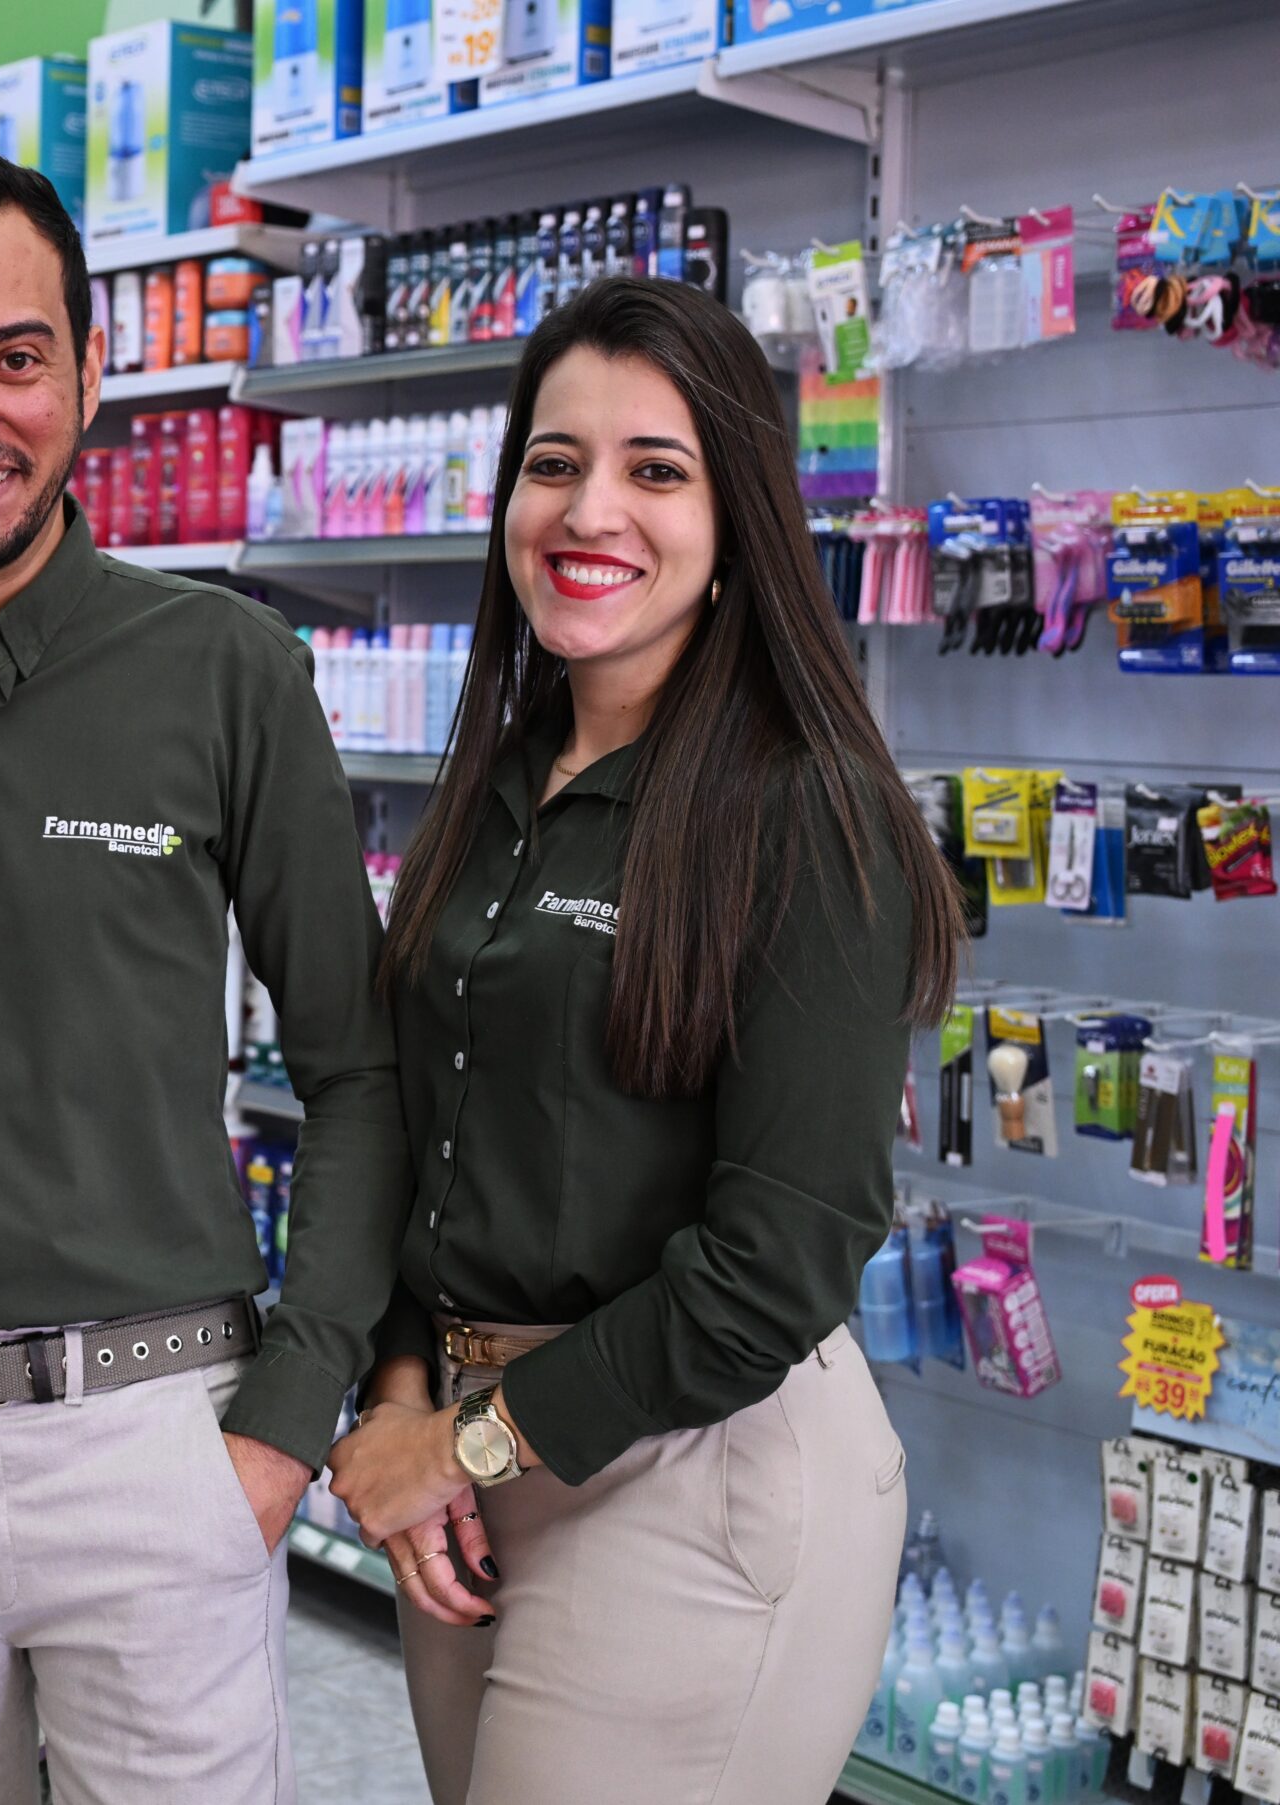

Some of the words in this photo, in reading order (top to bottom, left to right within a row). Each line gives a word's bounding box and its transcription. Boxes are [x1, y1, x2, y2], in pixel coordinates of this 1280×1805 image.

[44, 816, 160, 843] Farmamed
[108, 841, 159, 857] Barretos
[1134, 1284, 1179, 1303] OFERTA
[1153, 1378, 1186, 1409] 39
